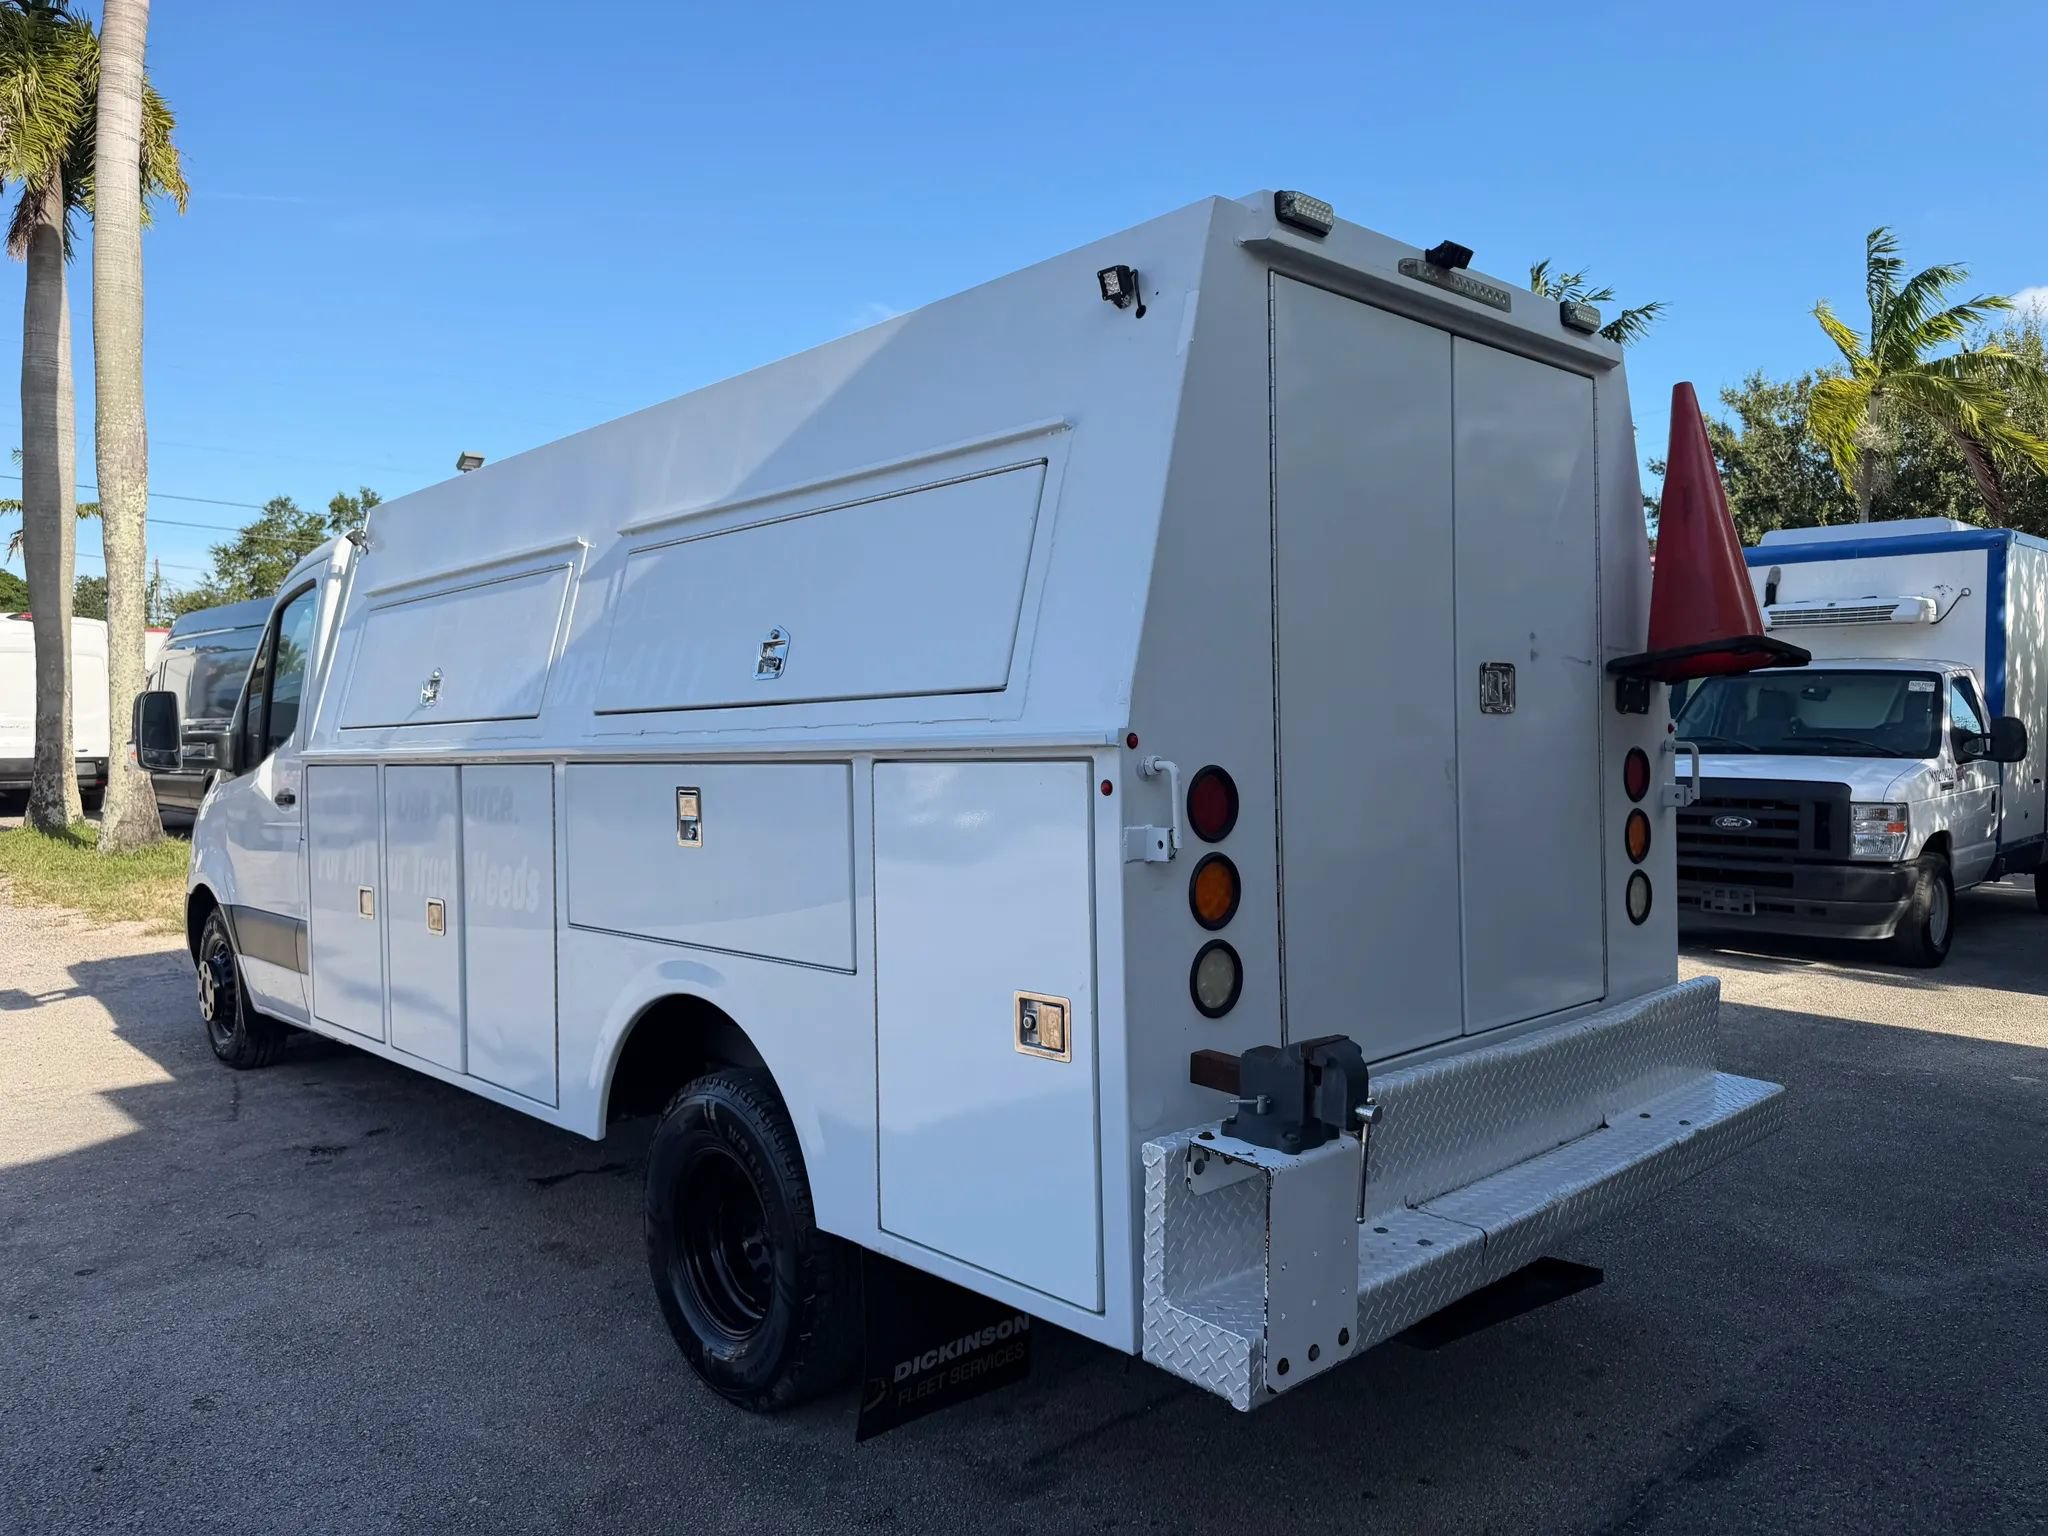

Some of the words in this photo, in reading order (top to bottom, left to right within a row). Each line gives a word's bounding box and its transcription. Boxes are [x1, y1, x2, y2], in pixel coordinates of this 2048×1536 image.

[470, 850, 541, 914] Needs
[893, 1314, 1031, 1383] DICKINSON
[897, 1372, 947, 1407] FLEET
[949, 1342, 1025, 1385] SERVICES
